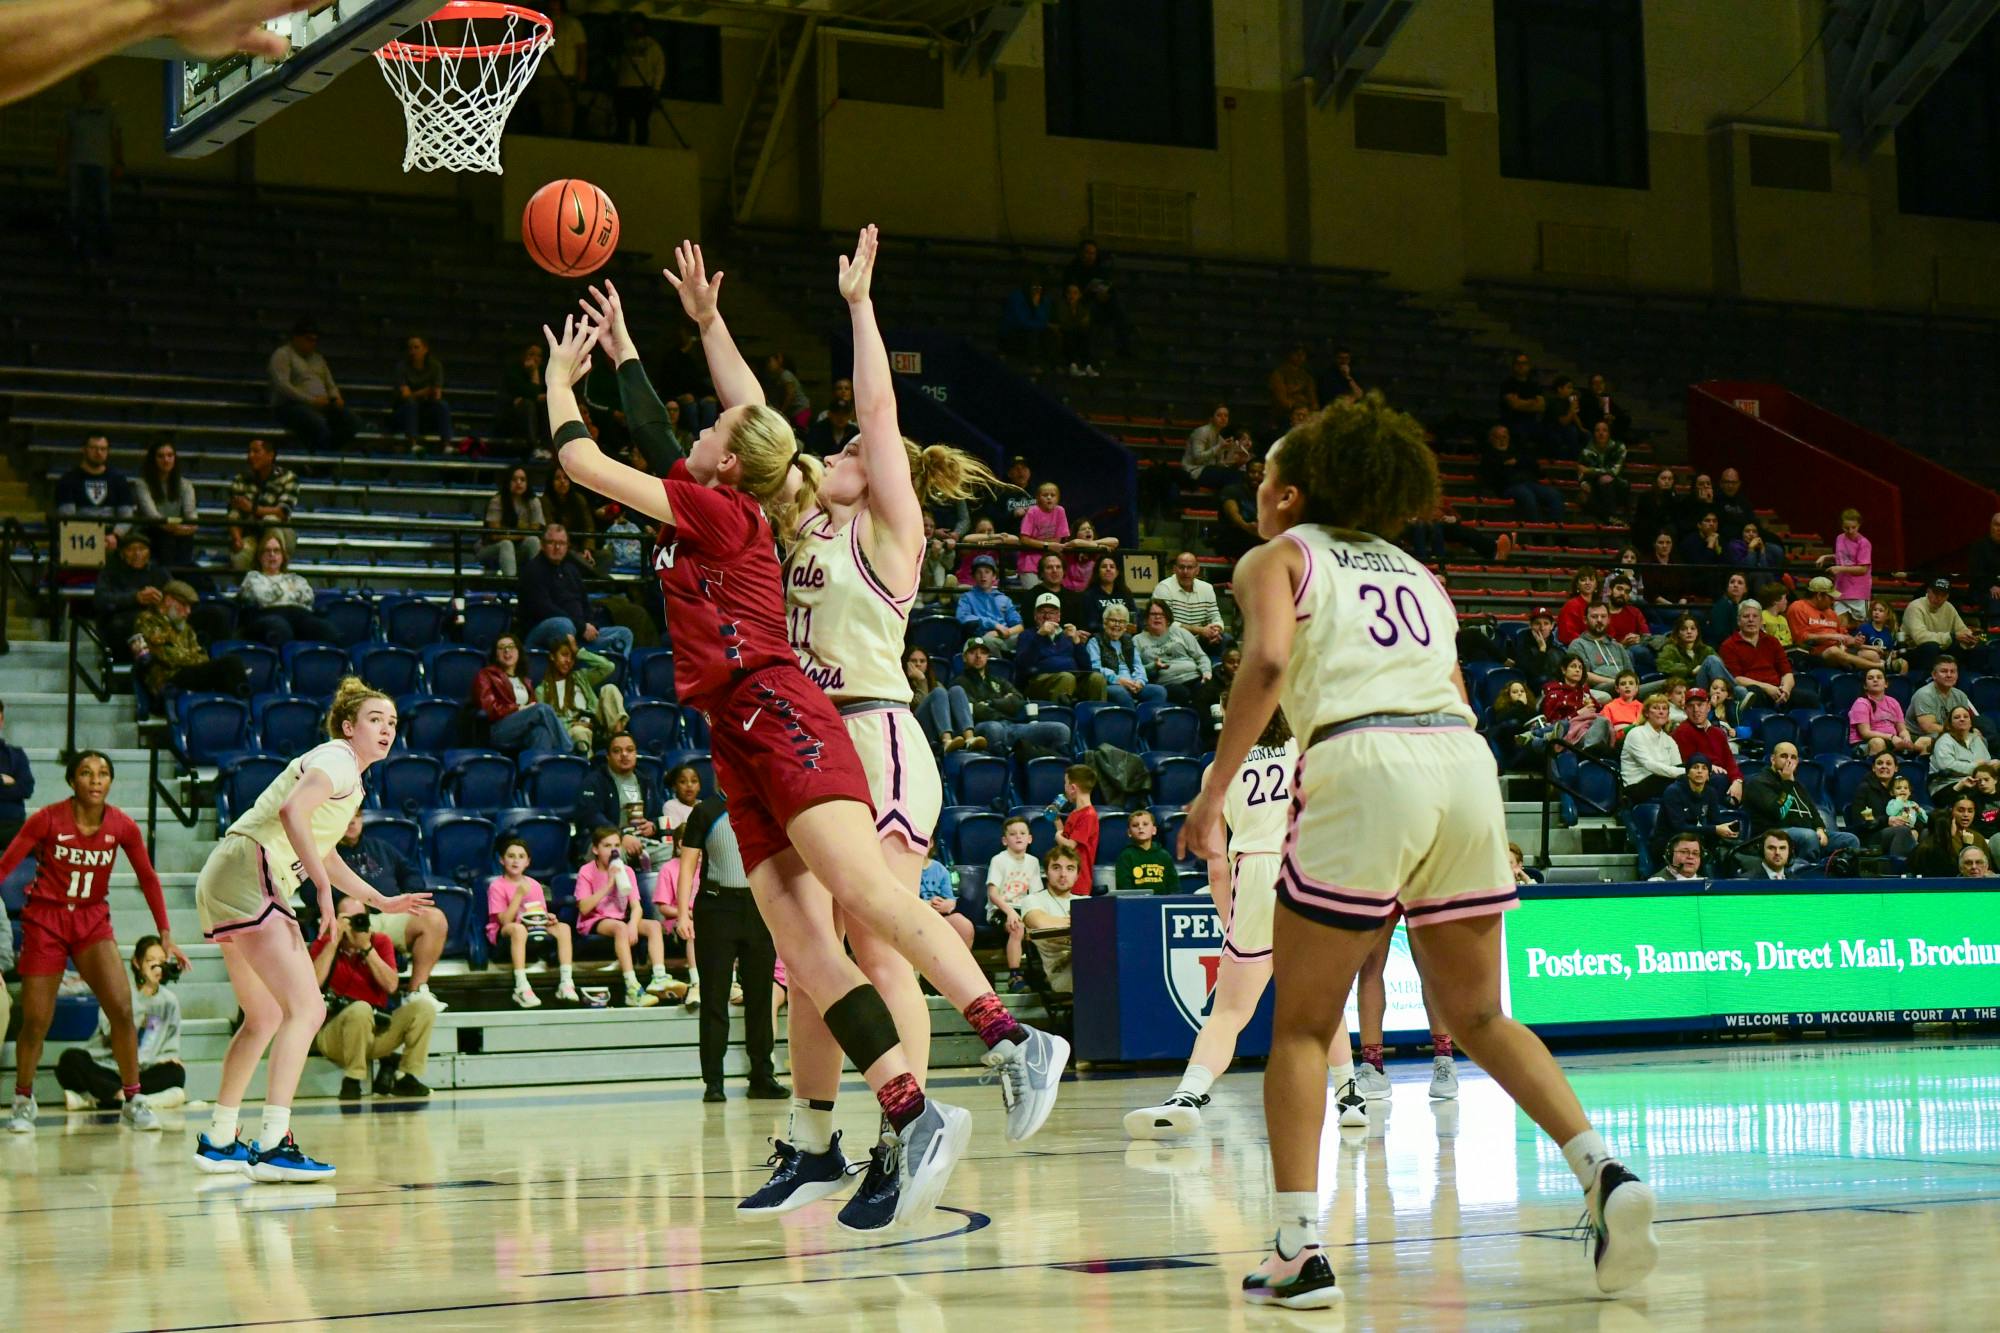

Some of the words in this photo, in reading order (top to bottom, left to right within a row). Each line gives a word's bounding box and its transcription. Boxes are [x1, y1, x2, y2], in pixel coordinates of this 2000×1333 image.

[69, 534, 96, 551] 114
[1130, 566, 1152, 580] 114
[1329, 548, 1418, 577] McGILL
[790, 607, 813, 649] 11
[1358, 583, 1431, 648] 30
[1243, 746, 1287, 764] DONALD
[1242, 764, 1289, 807] 22
[54, 844, 114, 867] PENN
[66, 871, 94, 899] 11
[1172, 914, 1224, 938] PEN
[1526, 947, 1632, 981] Posters,
[1635, 944, 1752, 977] Banners,
[1755, 941, 1834, 970] Direct
[1838, 938, 1905, 973] Mail,
[1725, 1014, 1789, 1027] WELCOME
[1797, 1013, 1814, 1024] TO
[1821, 1011, 1896, 1024] MACQUARIE
[1902, 1010, 1944, 1021] COURT
[1951, 1008, 1967, 1020] AT
[1975, 1007, 1997, 1019] THE
